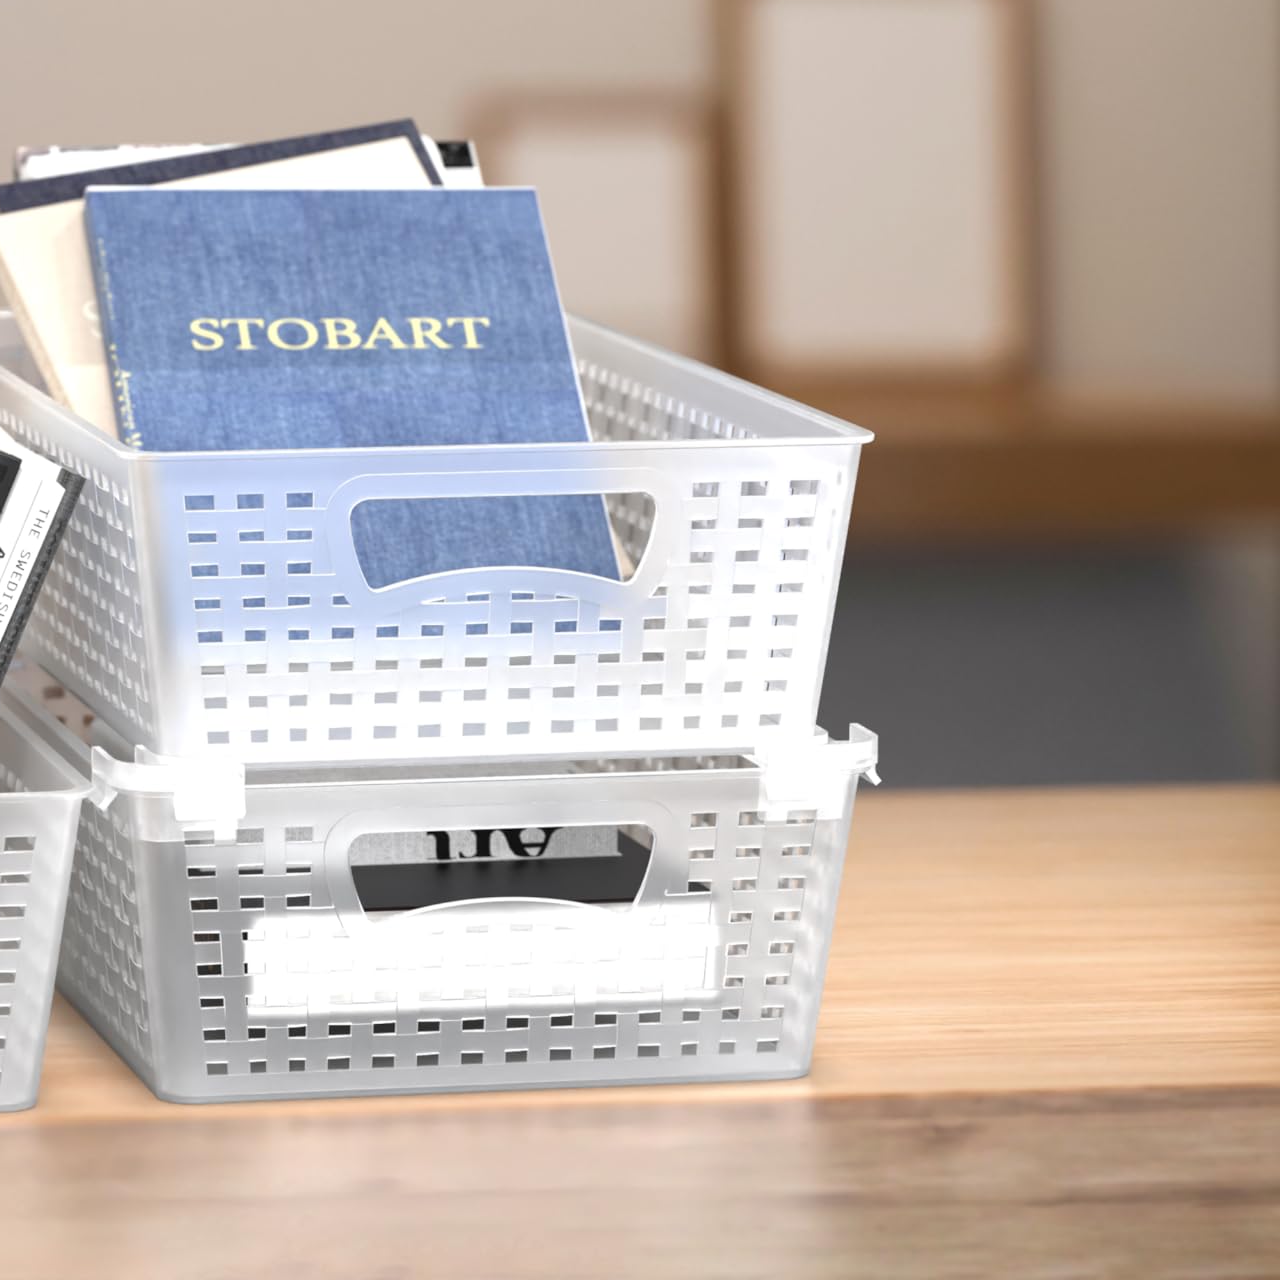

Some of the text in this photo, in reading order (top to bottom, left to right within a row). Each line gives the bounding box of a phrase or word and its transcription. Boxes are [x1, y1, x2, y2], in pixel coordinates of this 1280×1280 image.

[189, 316, 491, 351] STOBART
[28, 508, 51, 540] THE
[425, 826, 565, 861] Art
